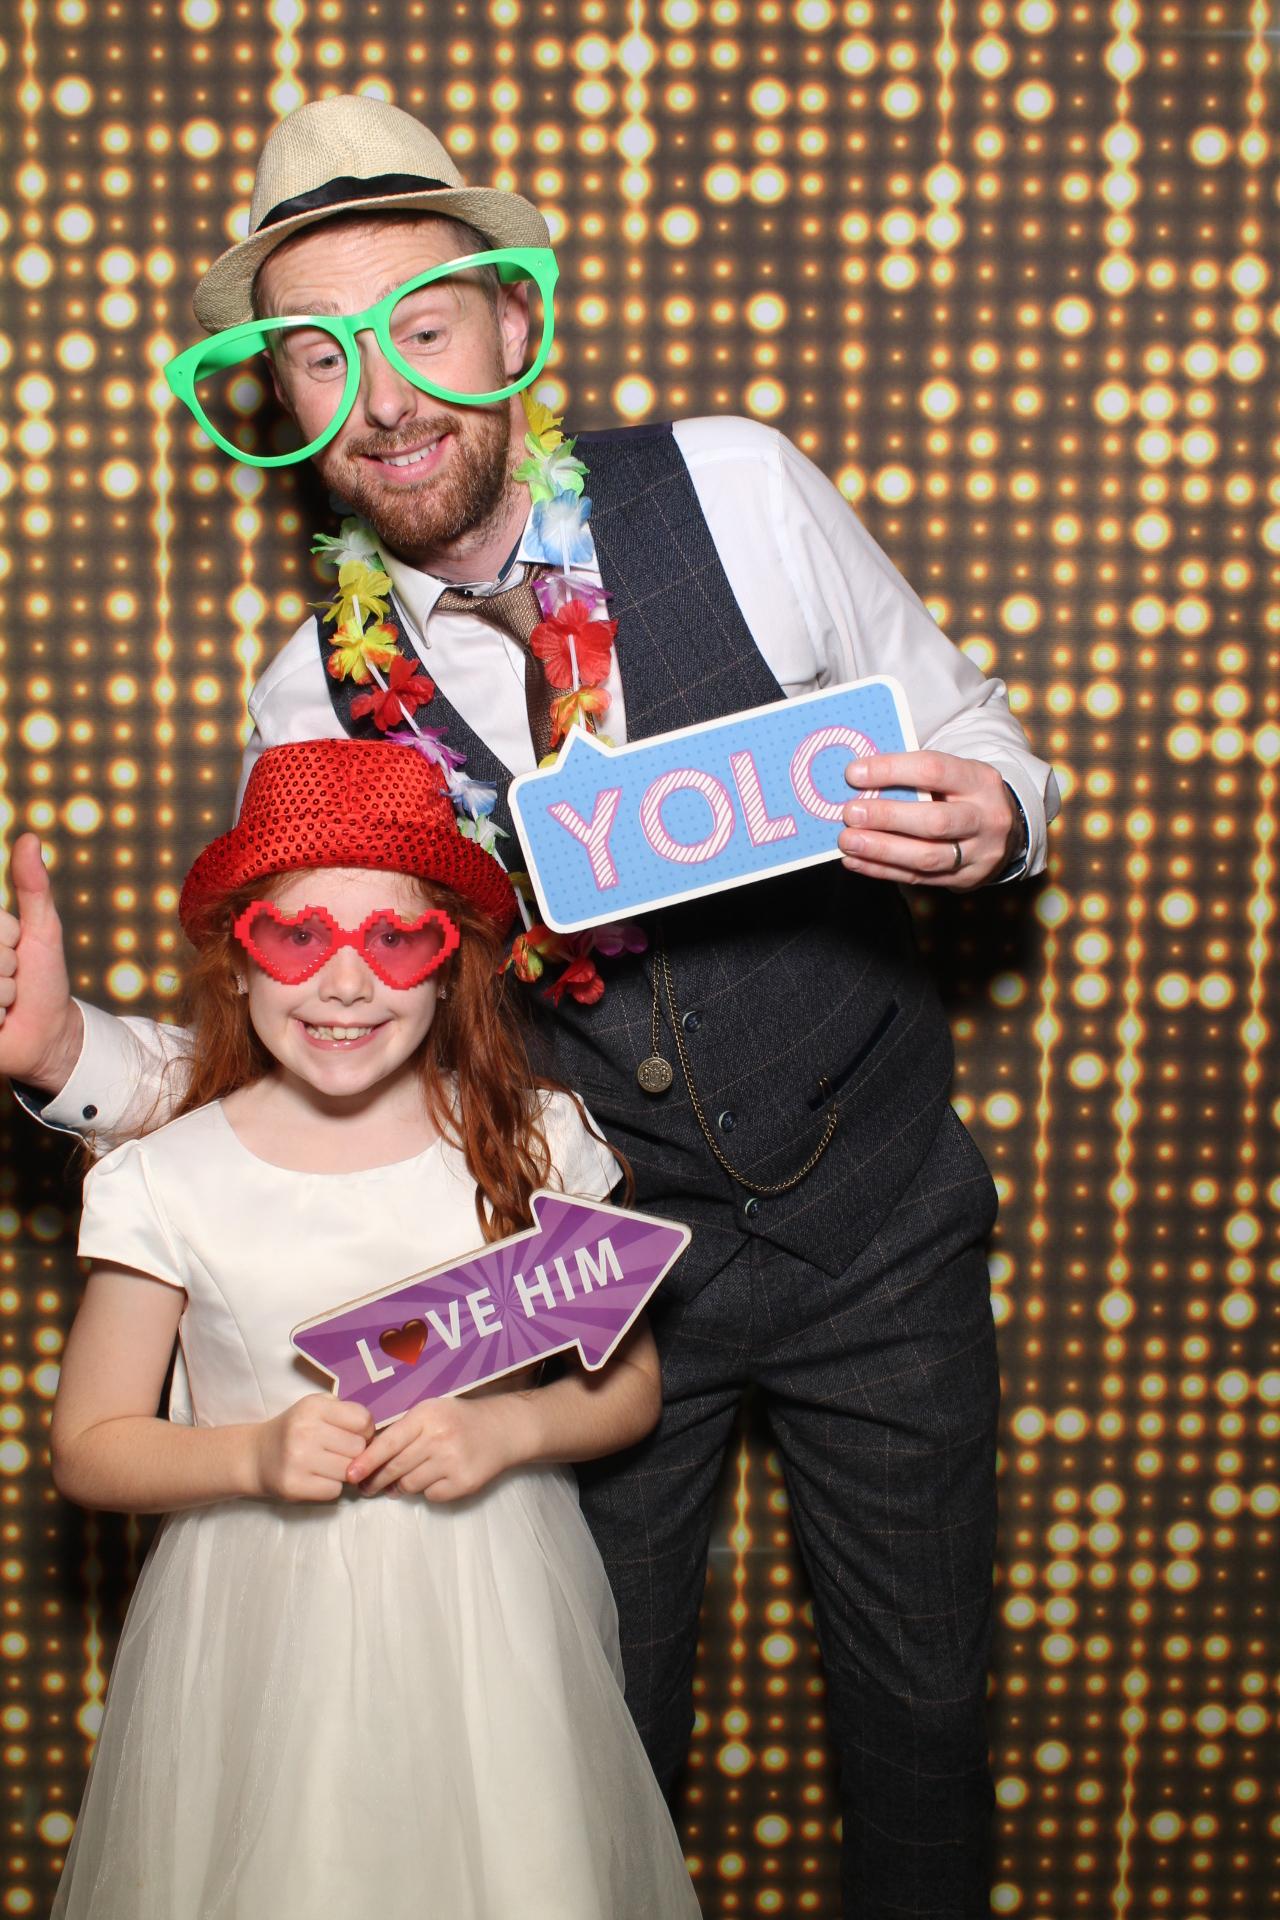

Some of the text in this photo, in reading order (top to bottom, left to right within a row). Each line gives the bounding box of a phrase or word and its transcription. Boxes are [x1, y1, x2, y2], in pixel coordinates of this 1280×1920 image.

[547, 725, 882, 891] YOLO
[356, 1237, 624, 1384] LVE HIM
